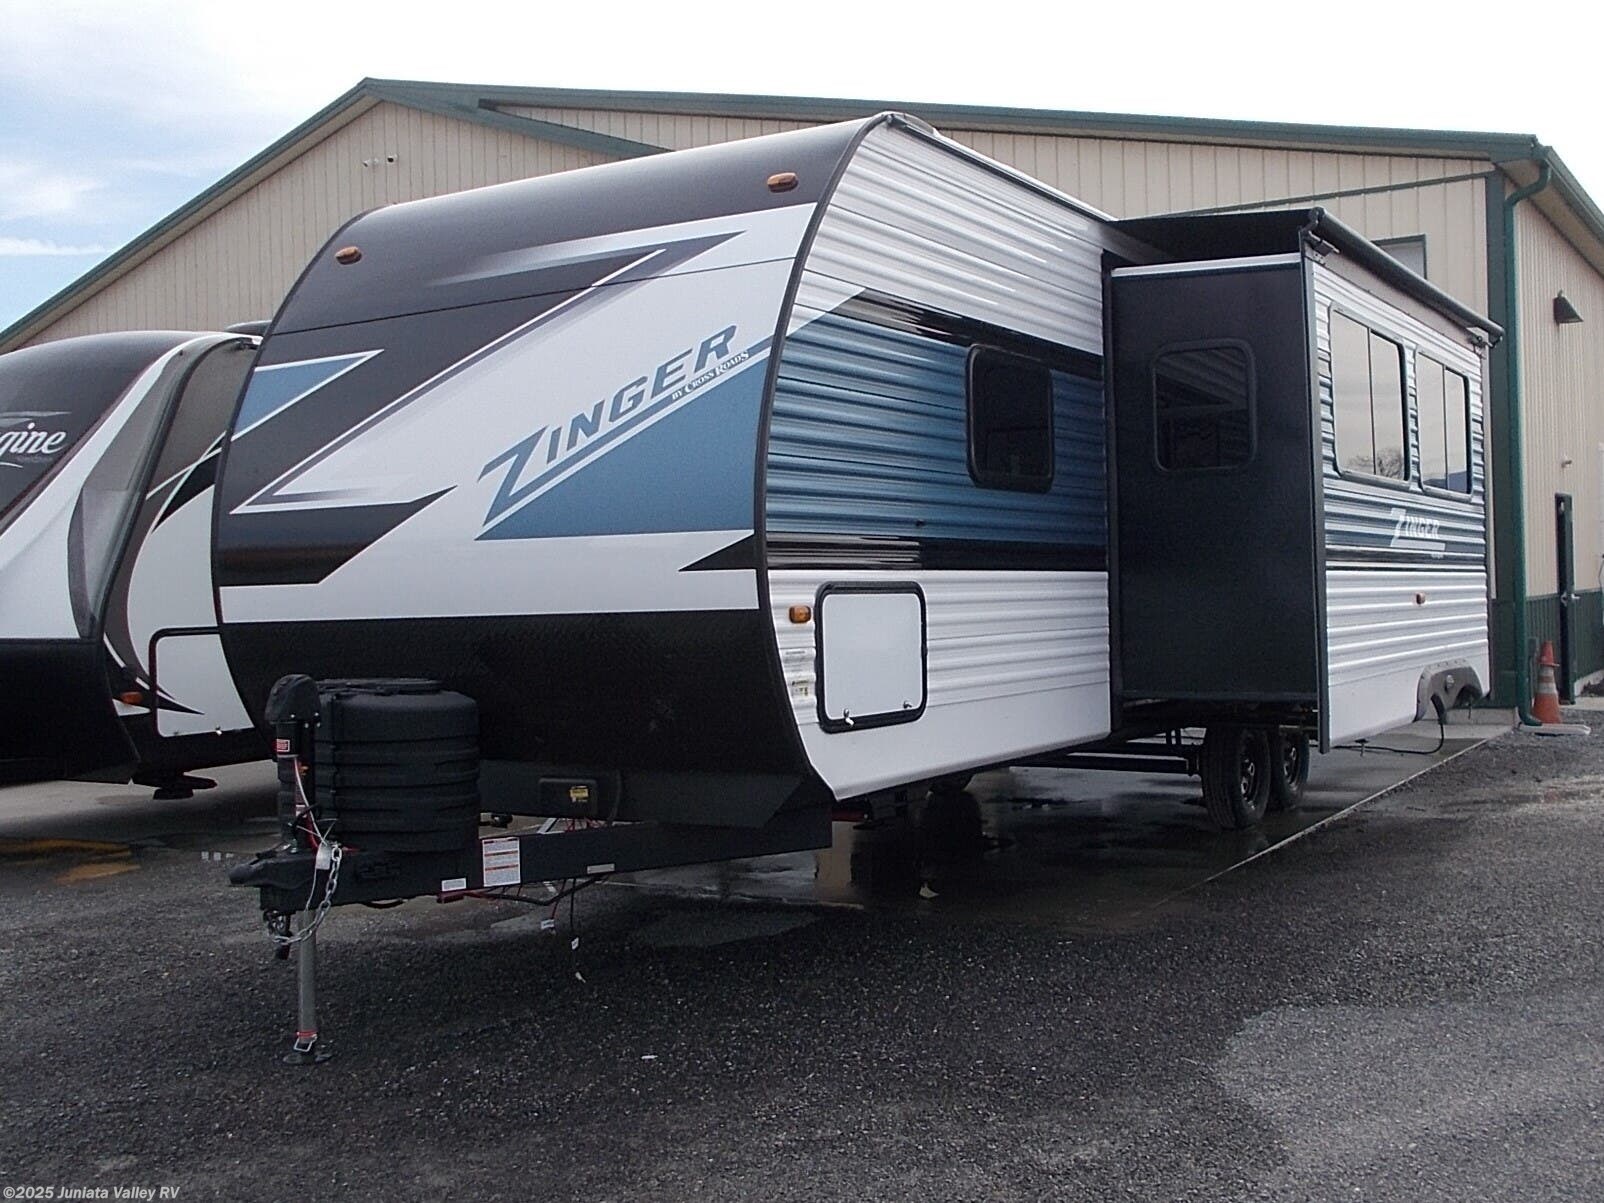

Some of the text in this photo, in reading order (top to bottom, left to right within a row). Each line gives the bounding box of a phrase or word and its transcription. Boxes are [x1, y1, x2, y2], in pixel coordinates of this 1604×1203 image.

[671, 389, 684, 401] BY
[476, 323, 739, 527] ZINGER
[1390, 507, 1445, 551] ZINGER
